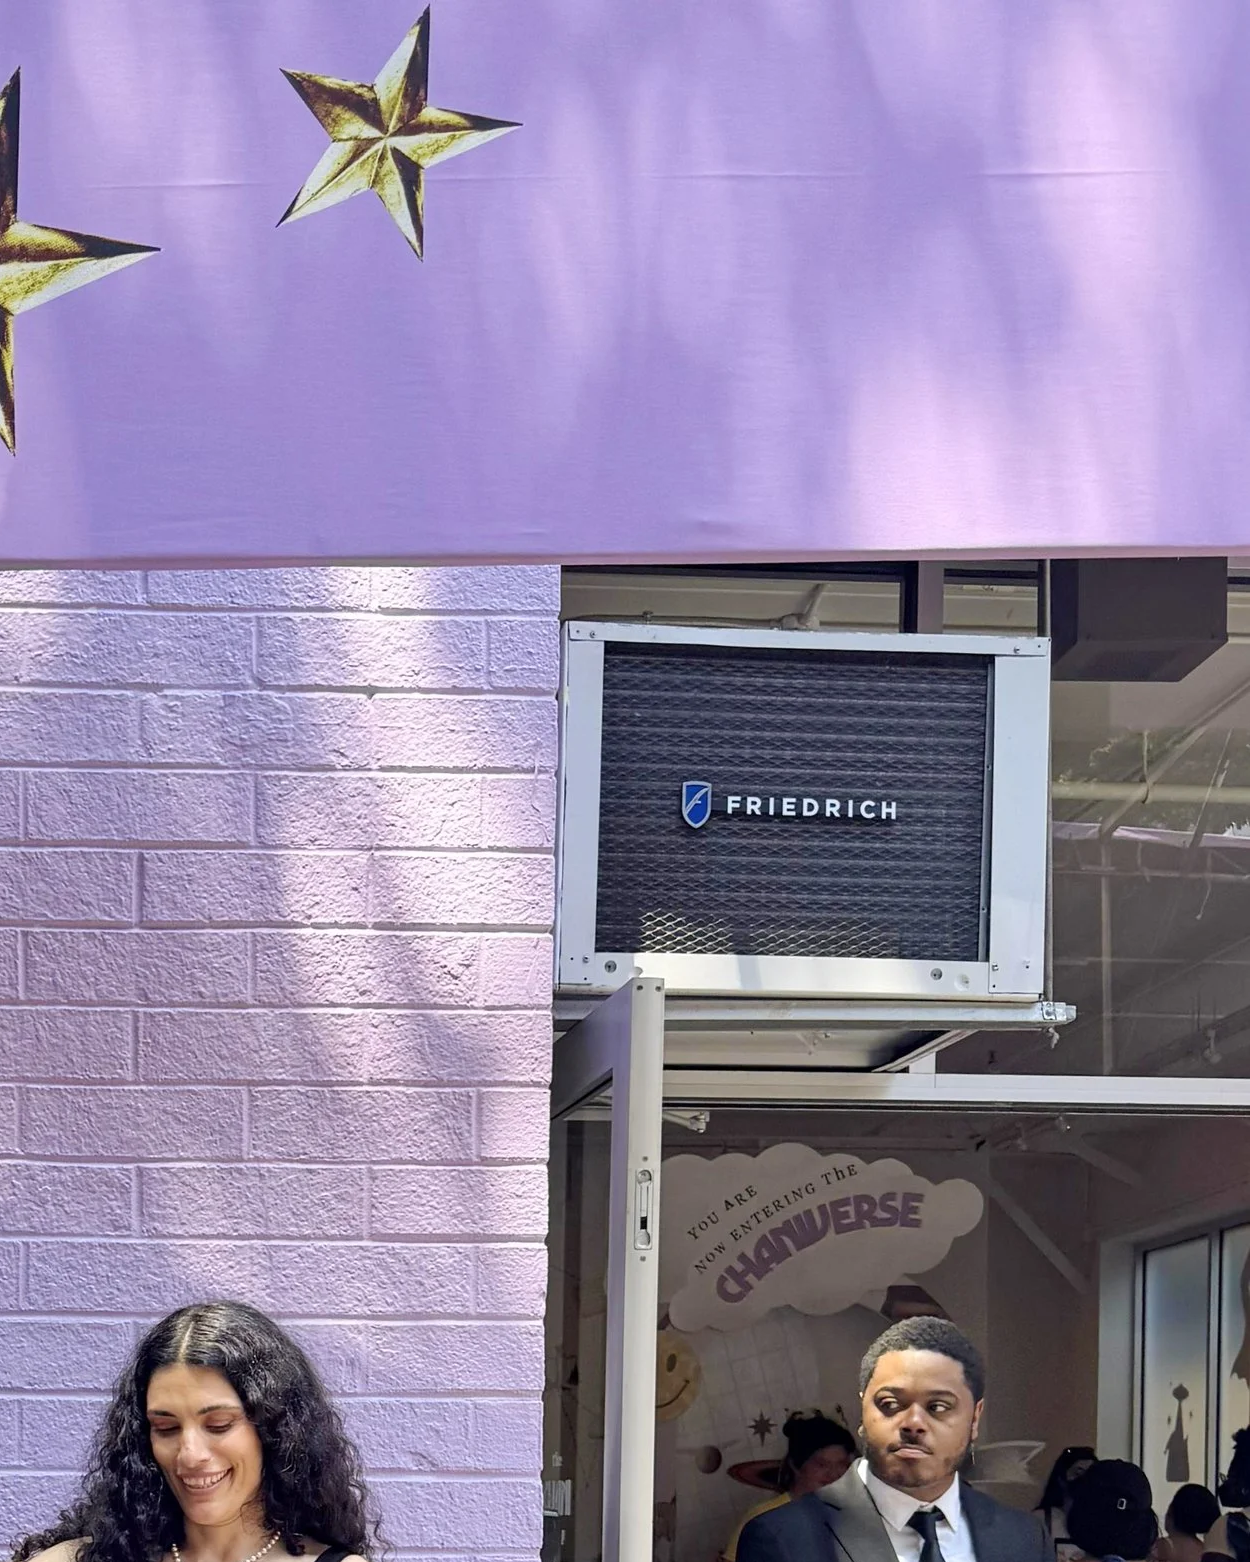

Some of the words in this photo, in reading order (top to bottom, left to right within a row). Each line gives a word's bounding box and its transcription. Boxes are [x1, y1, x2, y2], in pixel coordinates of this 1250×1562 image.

[726, 795, 897, 820] FRIEDRICH
[687, 1211, 720, 1241] YOU
[723, 1184, 758, 1212] ARE
[694, 1241, 727, 1275] NOW
[730, 1182, 816, 1242] ENTERING
[716, 1192, 925, 1304] CHANIVERSE
